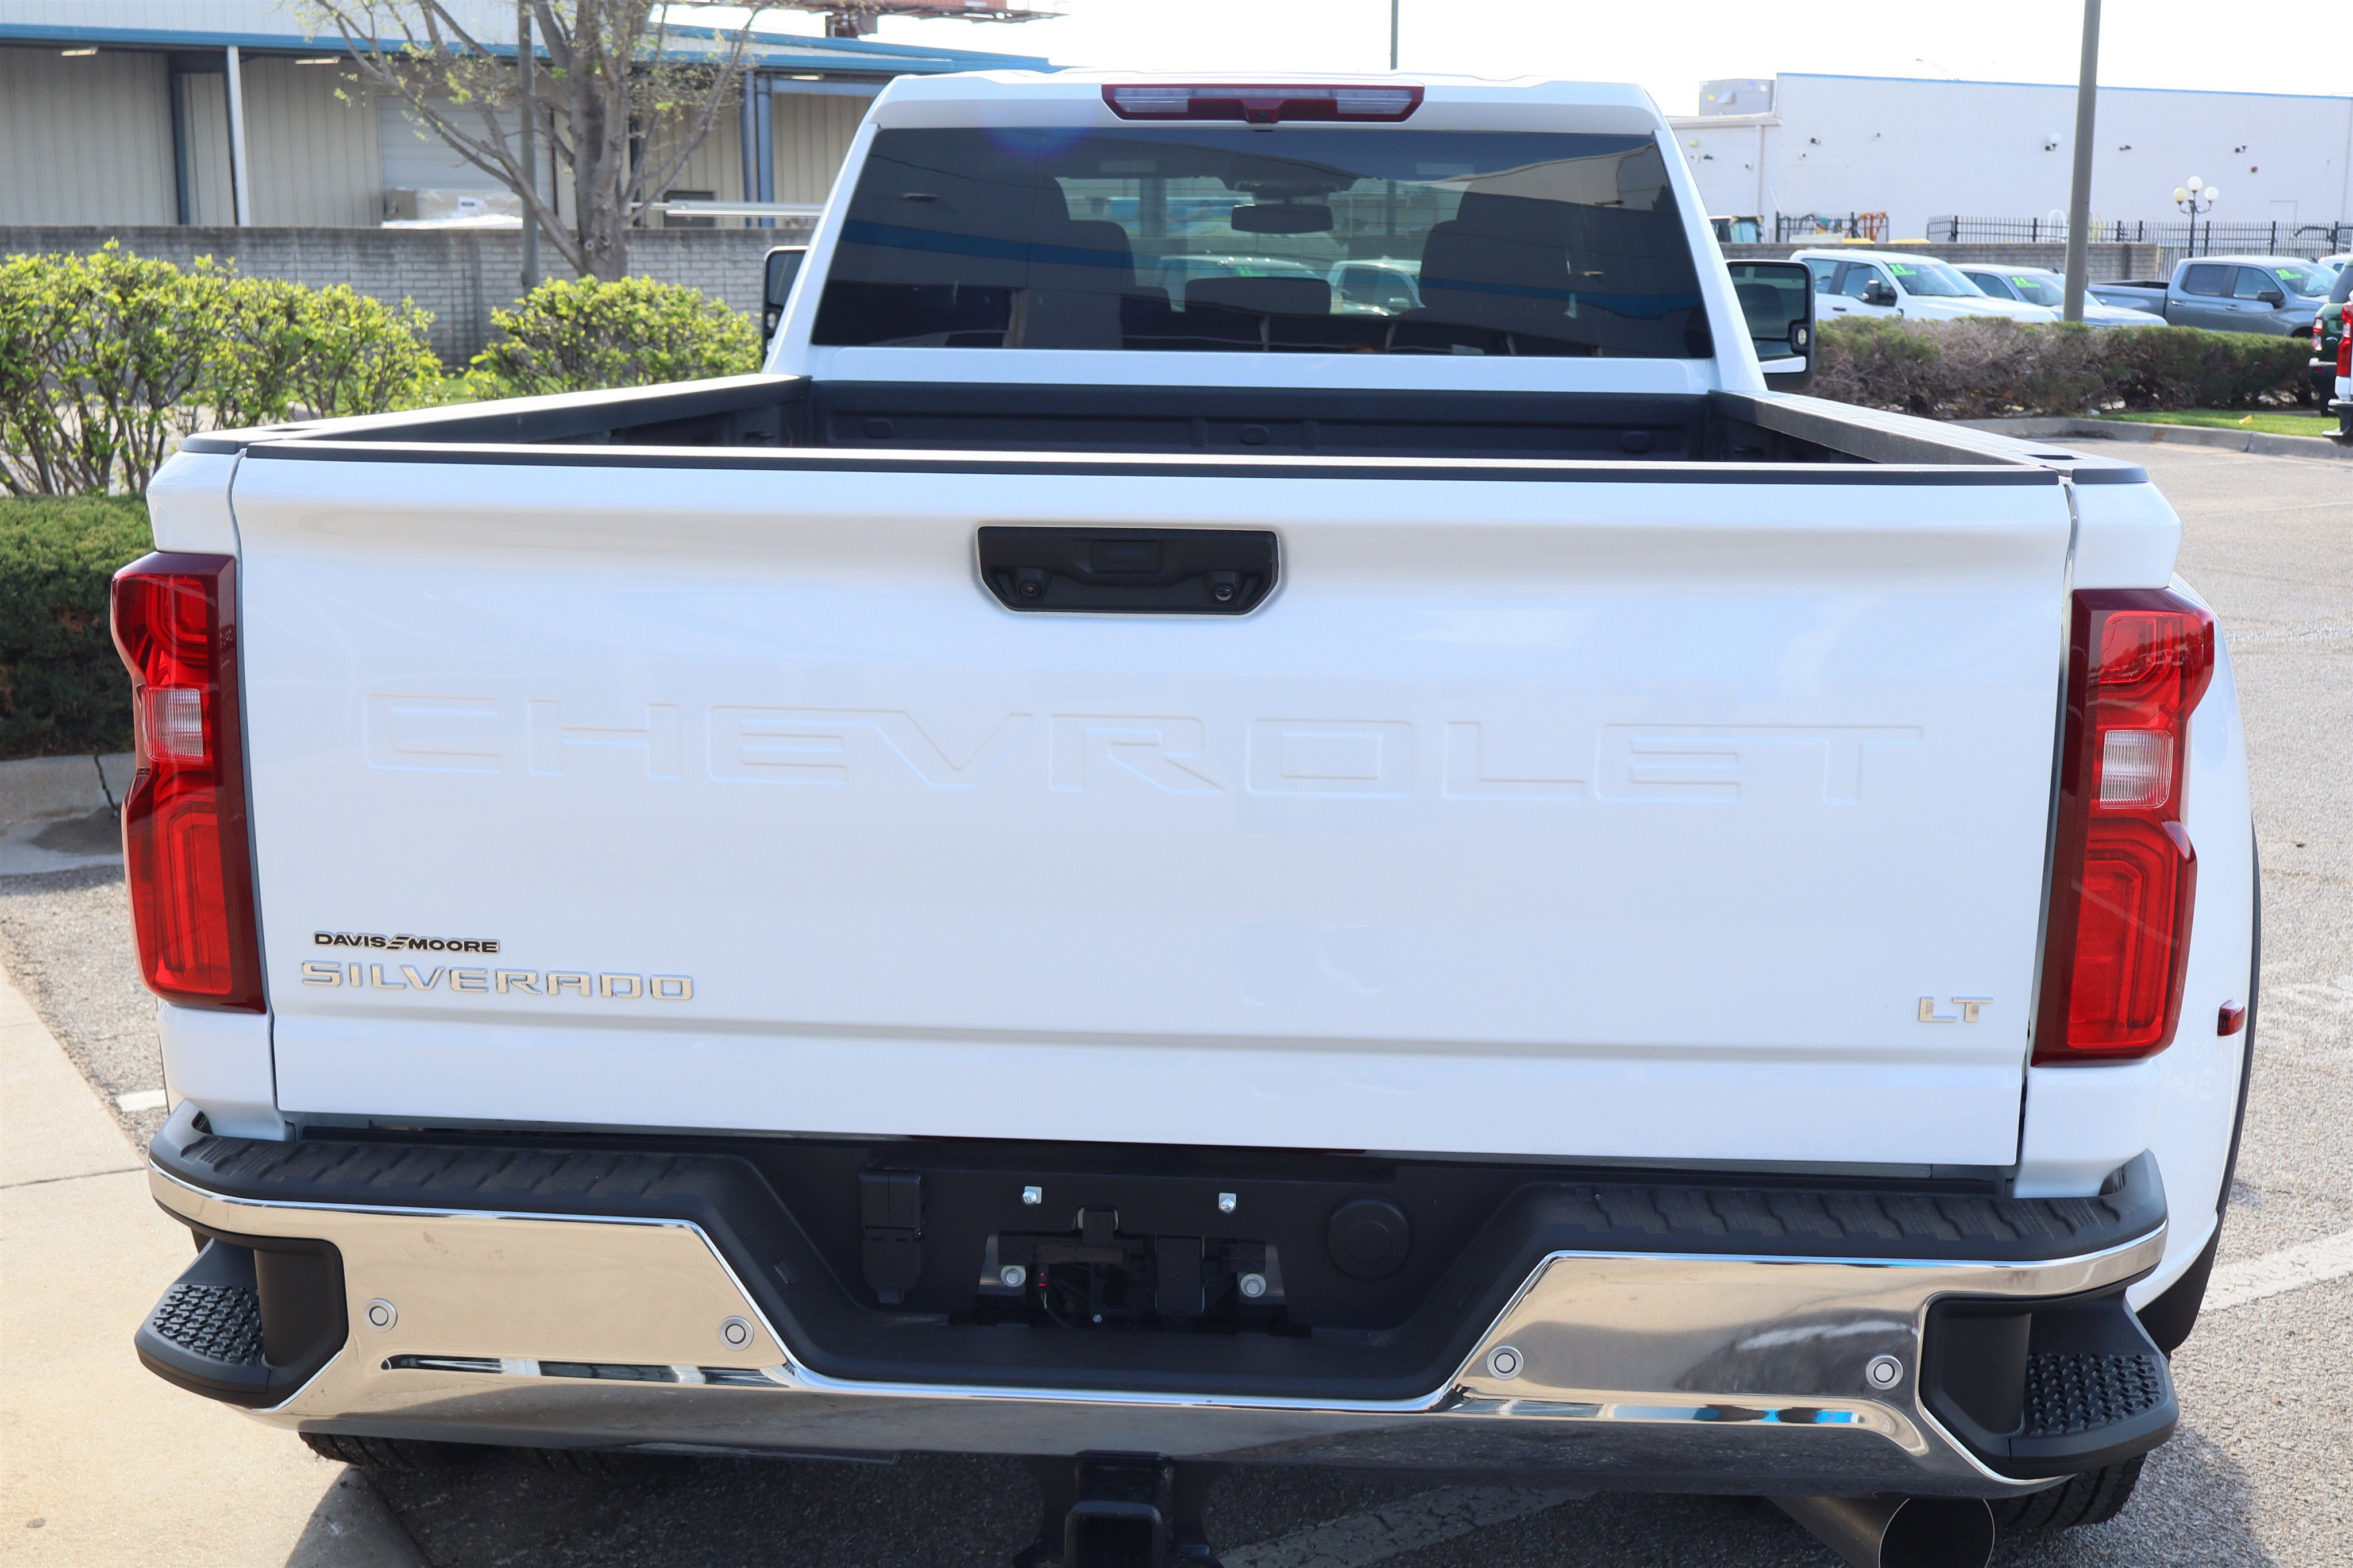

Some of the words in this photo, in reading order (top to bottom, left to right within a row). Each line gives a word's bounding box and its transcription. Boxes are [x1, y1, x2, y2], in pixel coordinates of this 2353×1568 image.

[365, 693, 1923, 805] CHEVROLET
[314, 931, 388, 948] DAVIS
[408, 936, 500, 954] MOORE
[302, 960, 695, 1001] SILVERADO
[1919, 997, 1994, 1022] LT
